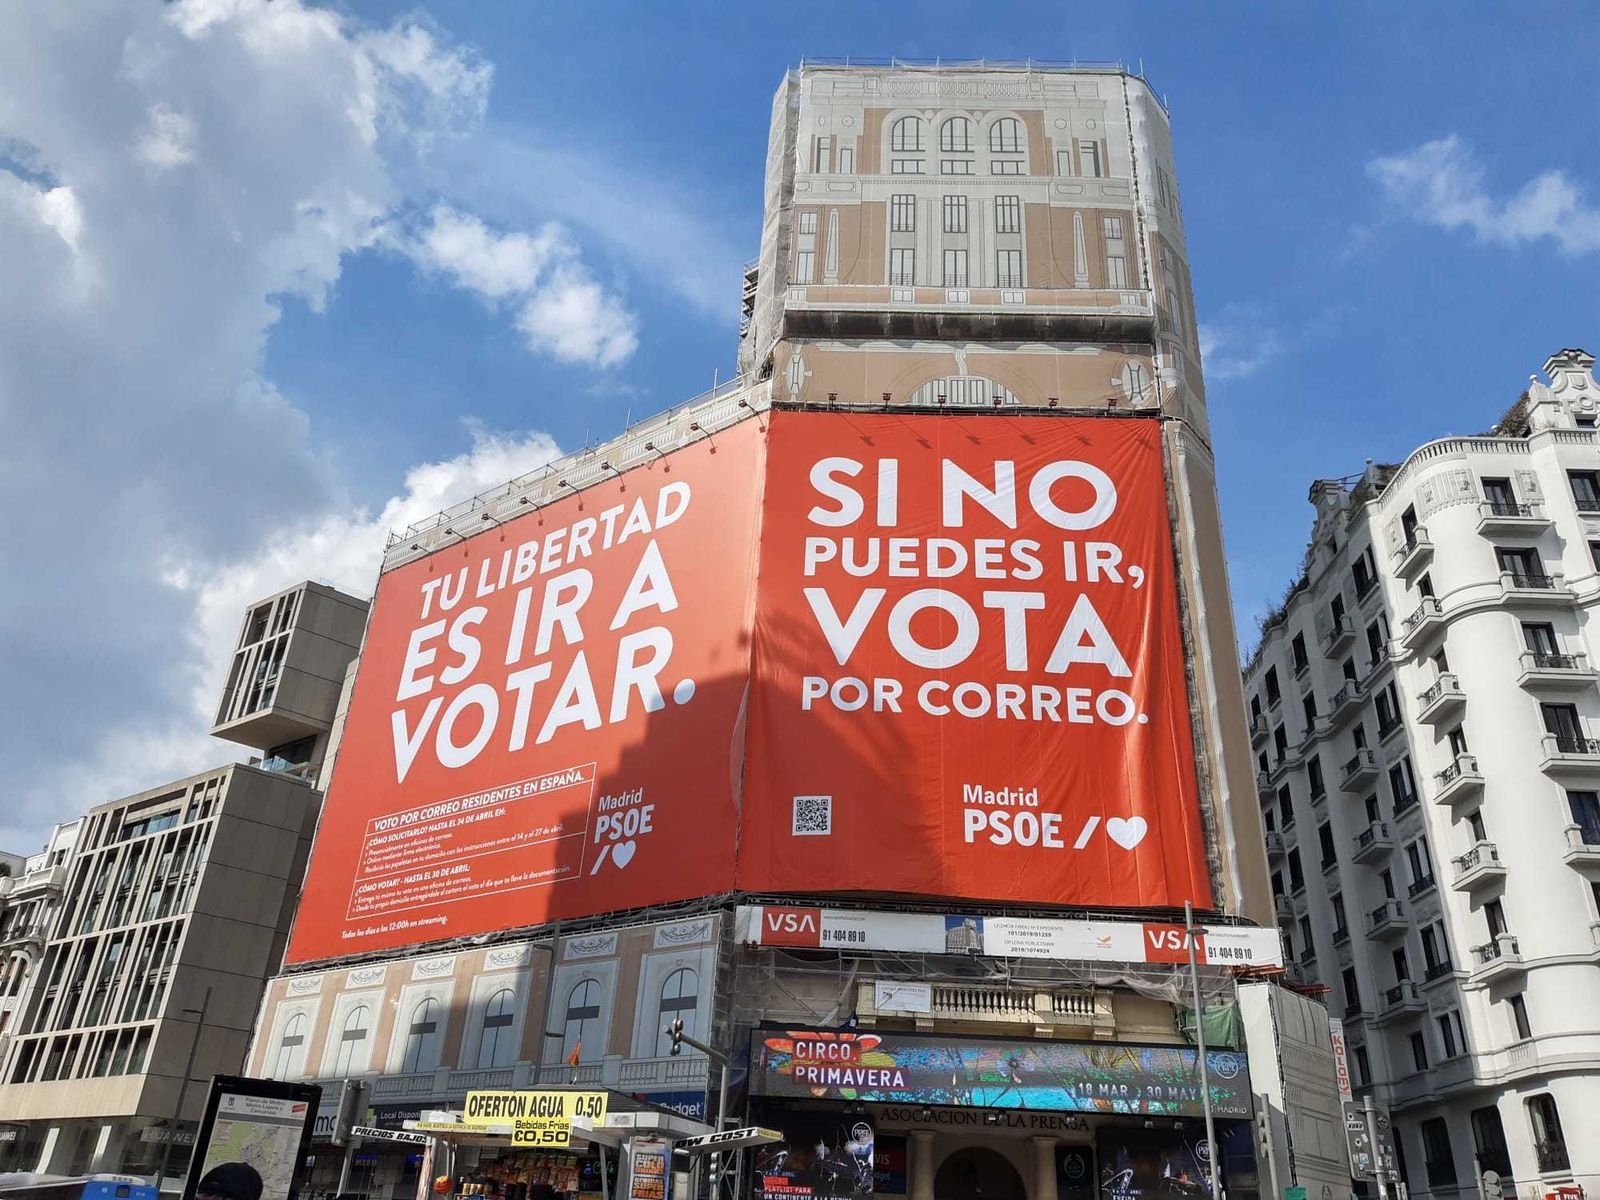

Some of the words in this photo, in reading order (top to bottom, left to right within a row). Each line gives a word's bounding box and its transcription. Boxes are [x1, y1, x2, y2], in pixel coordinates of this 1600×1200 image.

[807, 456, 898, 528] SI
[942, 458, 1118, 531] NO
[420, 566, 469, 620] TU
[476, 480, 692, 598] LIBERTAD
[803, 536, 1044, 580] PUEDES
[1063, 540, 1145, 590] IR,
[396, 605, 489, 702] ES
[505, 568, 594, 666] IR
[608, 538, 680, 632] A
[802, 588, 1134, 678] VOTA
[390, 626, 696, 784] VOTAR.
[801, 676, 904, 714] POR
[918, 680, 1149, 727] CORREO.
[374, 818, 398, 831] VOTO
[400, 812, 419, 826] POR
[420, 801, 460, 820] CORREO
[462, 785, 521, 810] RESIDENTES
[523, 781, 538, 795] EN
[540, 768, 584, 791] ESPAÑA.
[598, 786, 643, 812] Madrid
[962, 784, 1038, 807] Madrid
[388, 826, 428, 843] SOLICITARLO?
[428, 820, 448, 832] HASTA
[466, 816, 474, 824] DE
[475, 810, 494, 822] ABRIL
[594, 804, 655, 844] PSOE
[964, 808, 1064, 849] PSOE
[378, 878, 400, 890] VOTAR?
[404, 873, 424, 885] HASTA
[424, 871, 432, 880] EL
[432, 870, 440, 878] 30
[441, 867, 450, 876] DE
[342, 929, 356, 940] Todos
[389, 920, 410, 931] 12:00h
[767, 913, 816, 933] VSA
[822, 930, 831, 941] 91
[832, 930, 846, 942] 404
[848, 930, 857, 942] 89
[858, 931, 866, 942] 10
[1208, 946, 1217, 958] 91
[1220, 948, 1232, 958] 404
[1234, 948, 1244, 959] 89
[1244, 948, 1252, 960] 10
[796, 1066, 905, 1088] PRIMAVERA
[1099, 1084, 1129, 1098] MAR
[1168, 1086, 1197, 1101] MAY
[380, 1110, 397, 1120] Local
[530, 1096, 564, 1118] AGUA
[576, 1096, 603, 1118] 0.50
[515, 1120, 547, 1130] Bebidas
[880, 1108, 977, 1126] ASOCIACION
[1007, 1114, 1026, 1128] LA
[1030, 1115, 1090, 1132] PRENSA
[354, 1127, 394, 1139] PRECIOS
[396, 1133, 428, 1144] BAJOS
[514, 1130, 569, 1145] €0,50
[710, 1128, 756, 1143] COST
